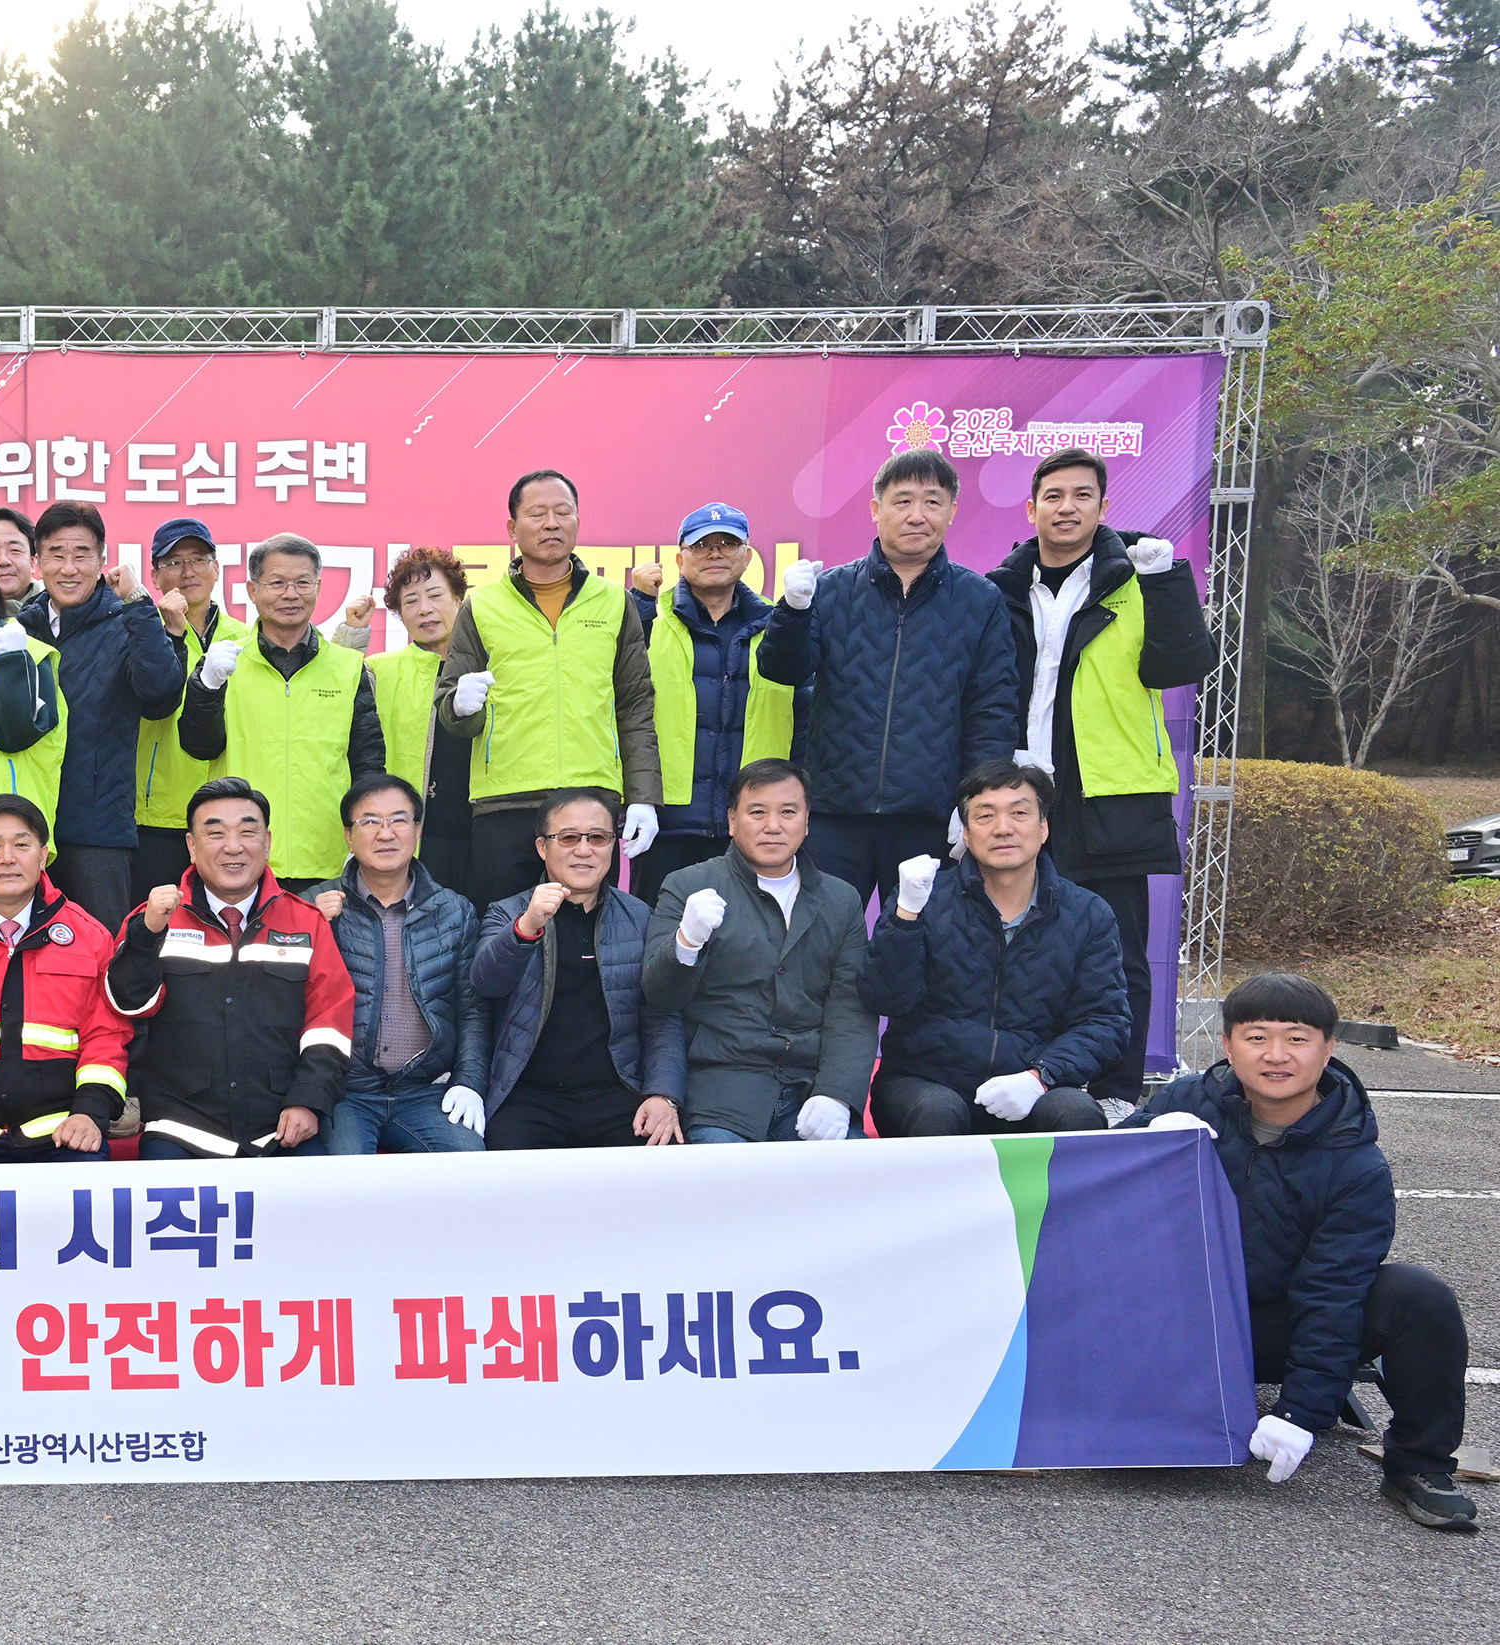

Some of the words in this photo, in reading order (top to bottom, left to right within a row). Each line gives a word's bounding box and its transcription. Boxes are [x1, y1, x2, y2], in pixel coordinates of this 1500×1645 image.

[954, 409, 1012, 431] 2028
[1126, 423, 1142, 432] Expo
[124, 442, 237, 506] 도심
[254, 439, 367, 504] 주변
[57, 1185, 254, 1268] 시작!
[15, 1298, 355, 1392] 안전하게
[393, 1290, 860, 1384] 파쇄하세요.
